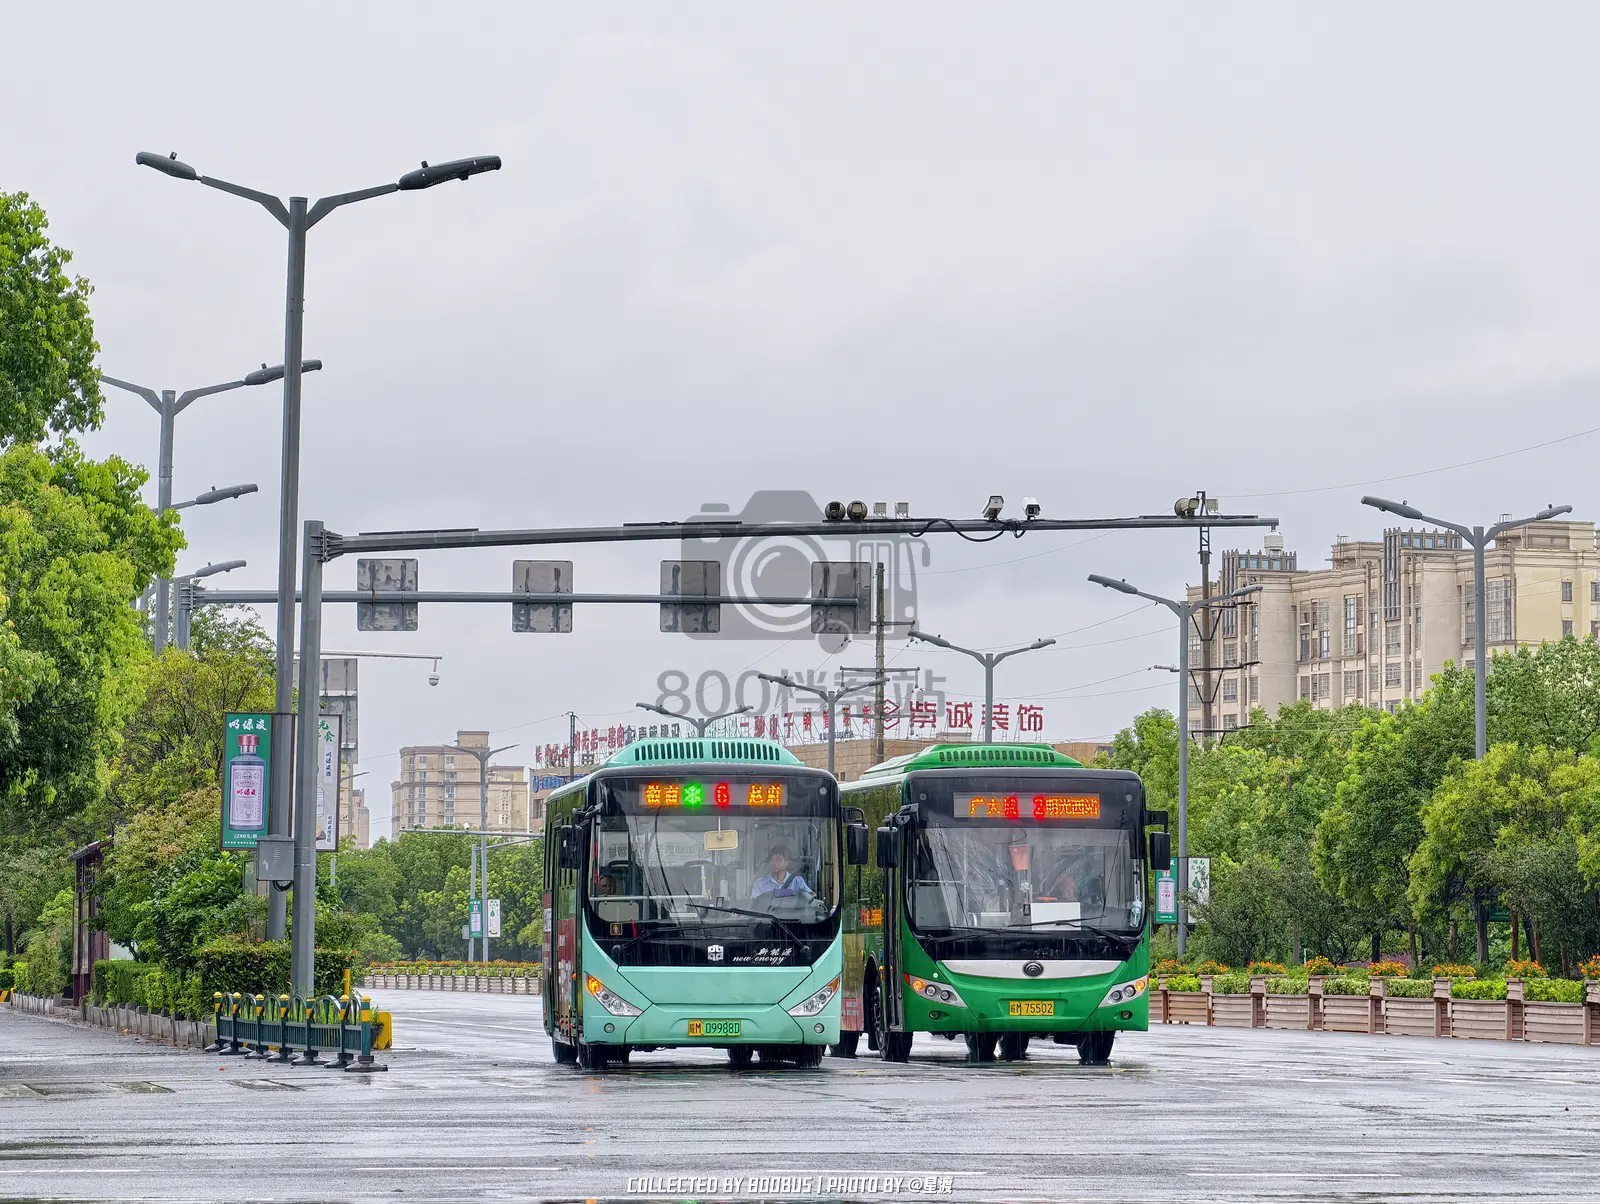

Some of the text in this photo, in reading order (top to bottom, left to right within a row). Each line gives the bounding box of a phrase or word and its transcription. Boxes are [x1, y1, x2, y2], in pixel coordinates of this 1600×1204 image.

[717, 784, 728, 804] 6
[1034, 798, 1045, 815] 2
[1046, 798, 1098, 816] 明光西站
[754, 956, 785, 965] energy
